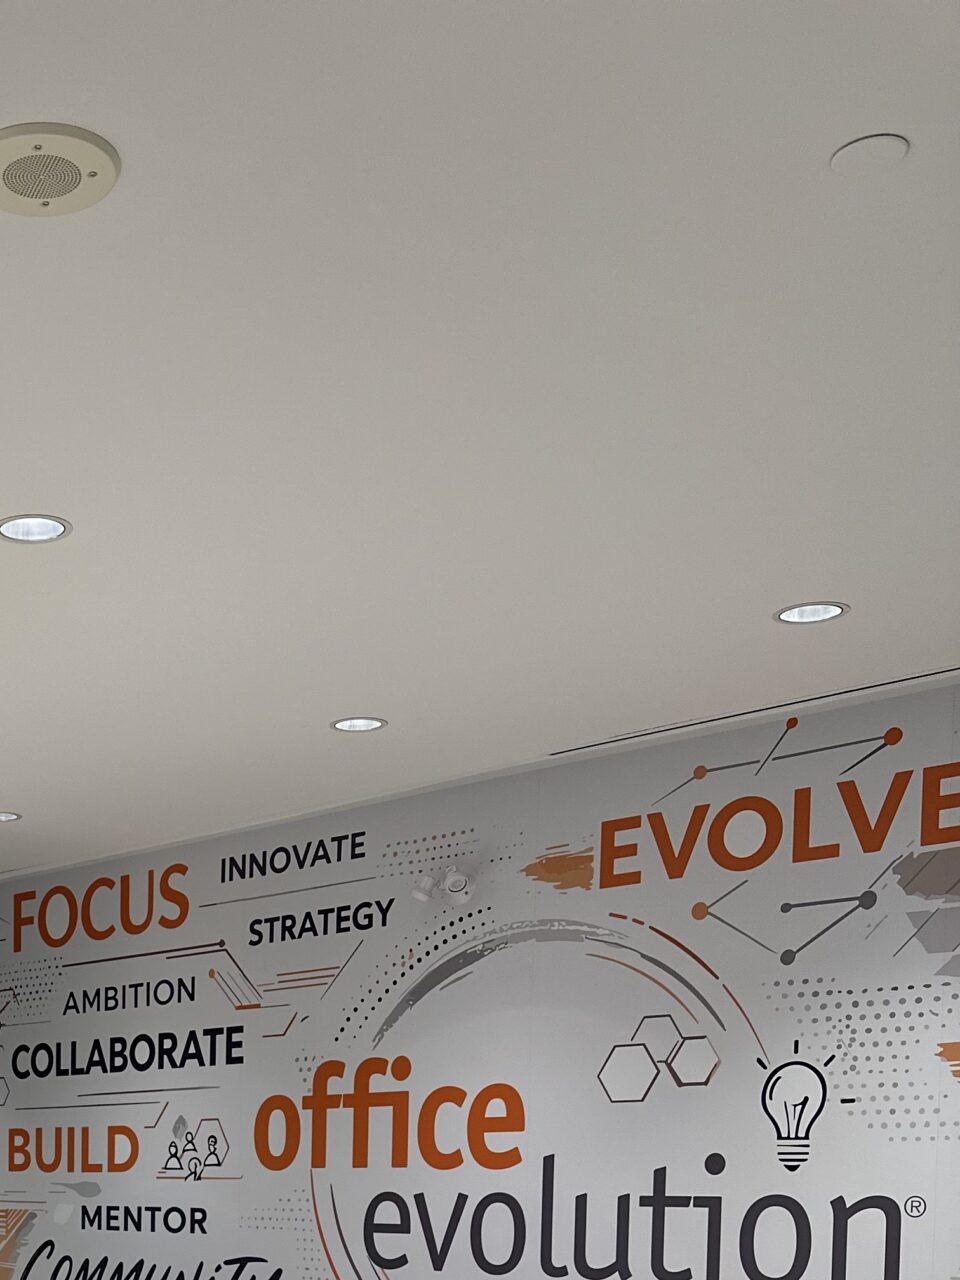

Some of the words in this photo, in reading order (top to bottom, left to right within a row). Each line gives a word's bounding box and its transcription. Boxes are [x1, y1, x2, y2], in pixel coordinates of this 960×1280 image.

[599, 762, 960, 889] EVOLVE
[220, 831, 367, 883] INNOVATE
[13, 863, 190, 953] FOCUS
[248, 899, 395, 946] STRATEGY
[62, 976, 196, 1015] AMBITION
[11, 1026, 245, 1079] COLLABORATE
[254, 1055, 525, 1171] office
[8, 1125, 139, 1173] BUILD
[81, 1205, 208, 1234] MENTOR
